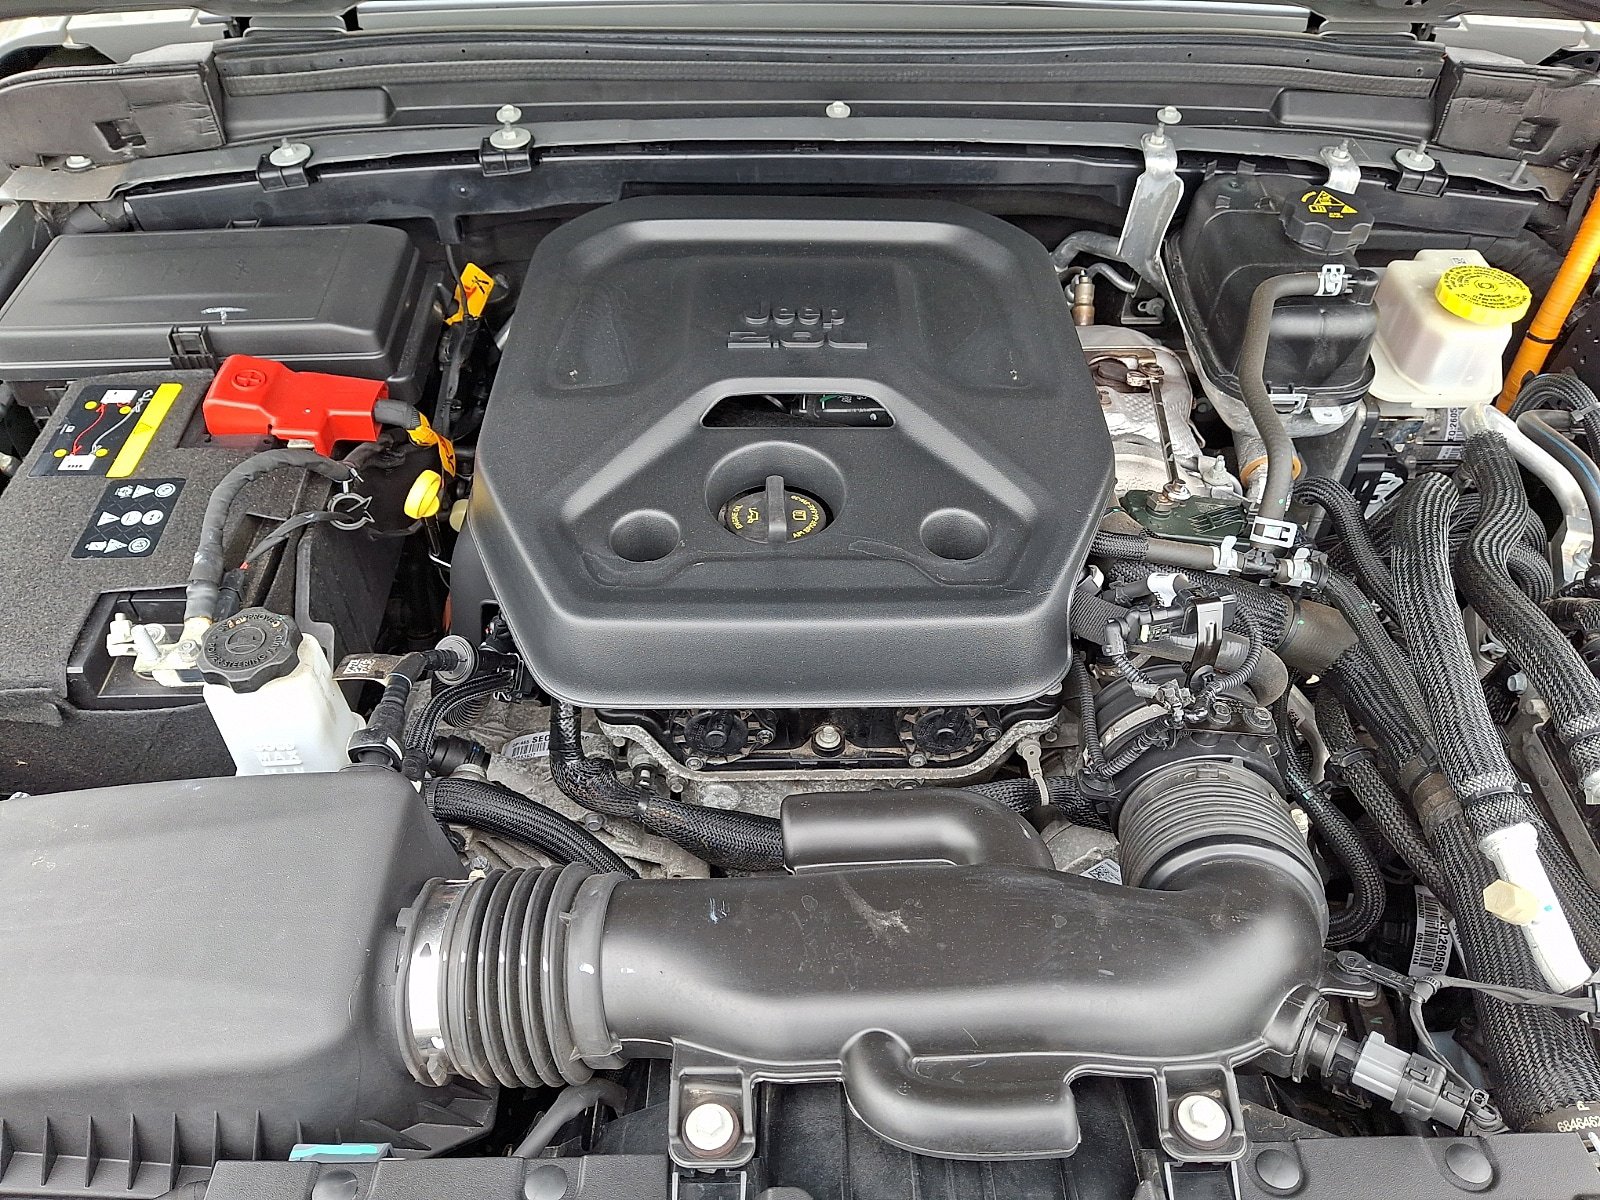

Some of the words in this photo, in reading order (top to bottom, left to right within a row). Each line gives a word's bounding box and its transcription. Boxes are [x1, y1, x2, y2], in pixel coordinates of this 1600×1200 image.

[743, 300, 846, 330] Jeep
[727, 331, 868, 350] 2.0L
[223, 653, 267, 668] STEERING
